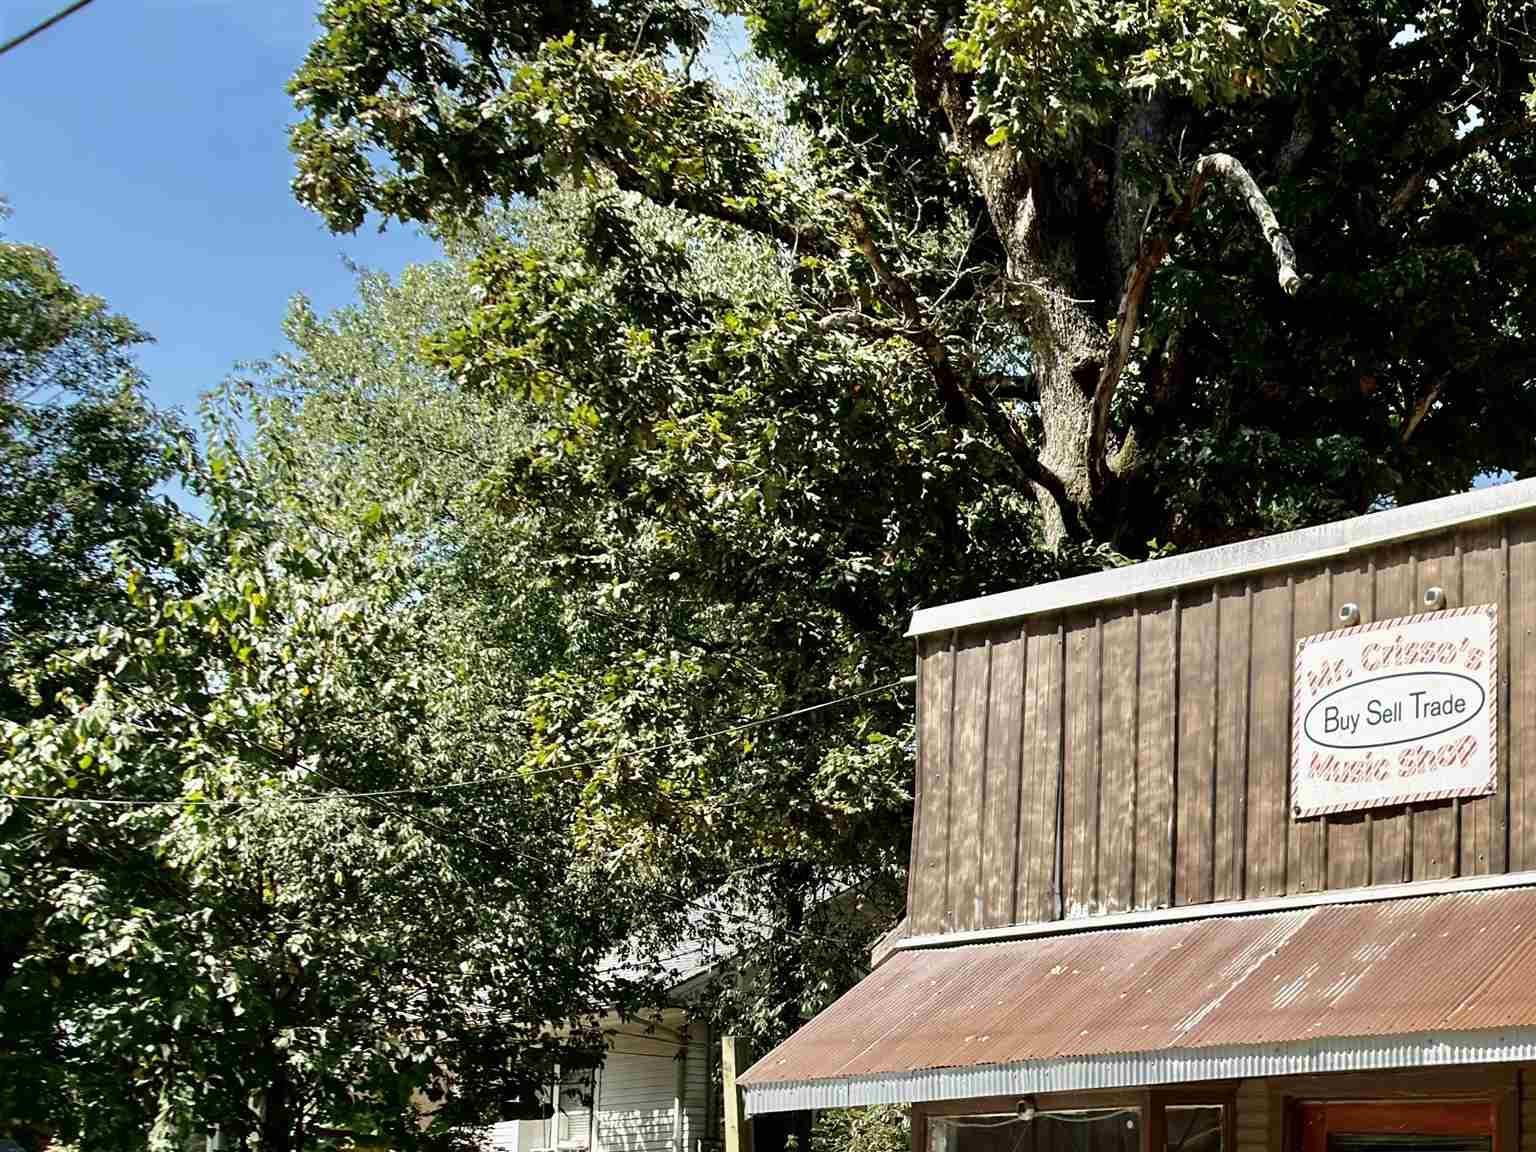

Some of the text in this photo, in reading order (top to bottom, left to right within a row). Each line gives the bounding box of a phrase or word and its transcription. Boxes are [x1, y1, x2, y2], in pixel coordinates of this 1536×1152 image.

[1324, 691, 1467, 734] Buy Sell Trade
[1309, 752, 1390, 783] Music
